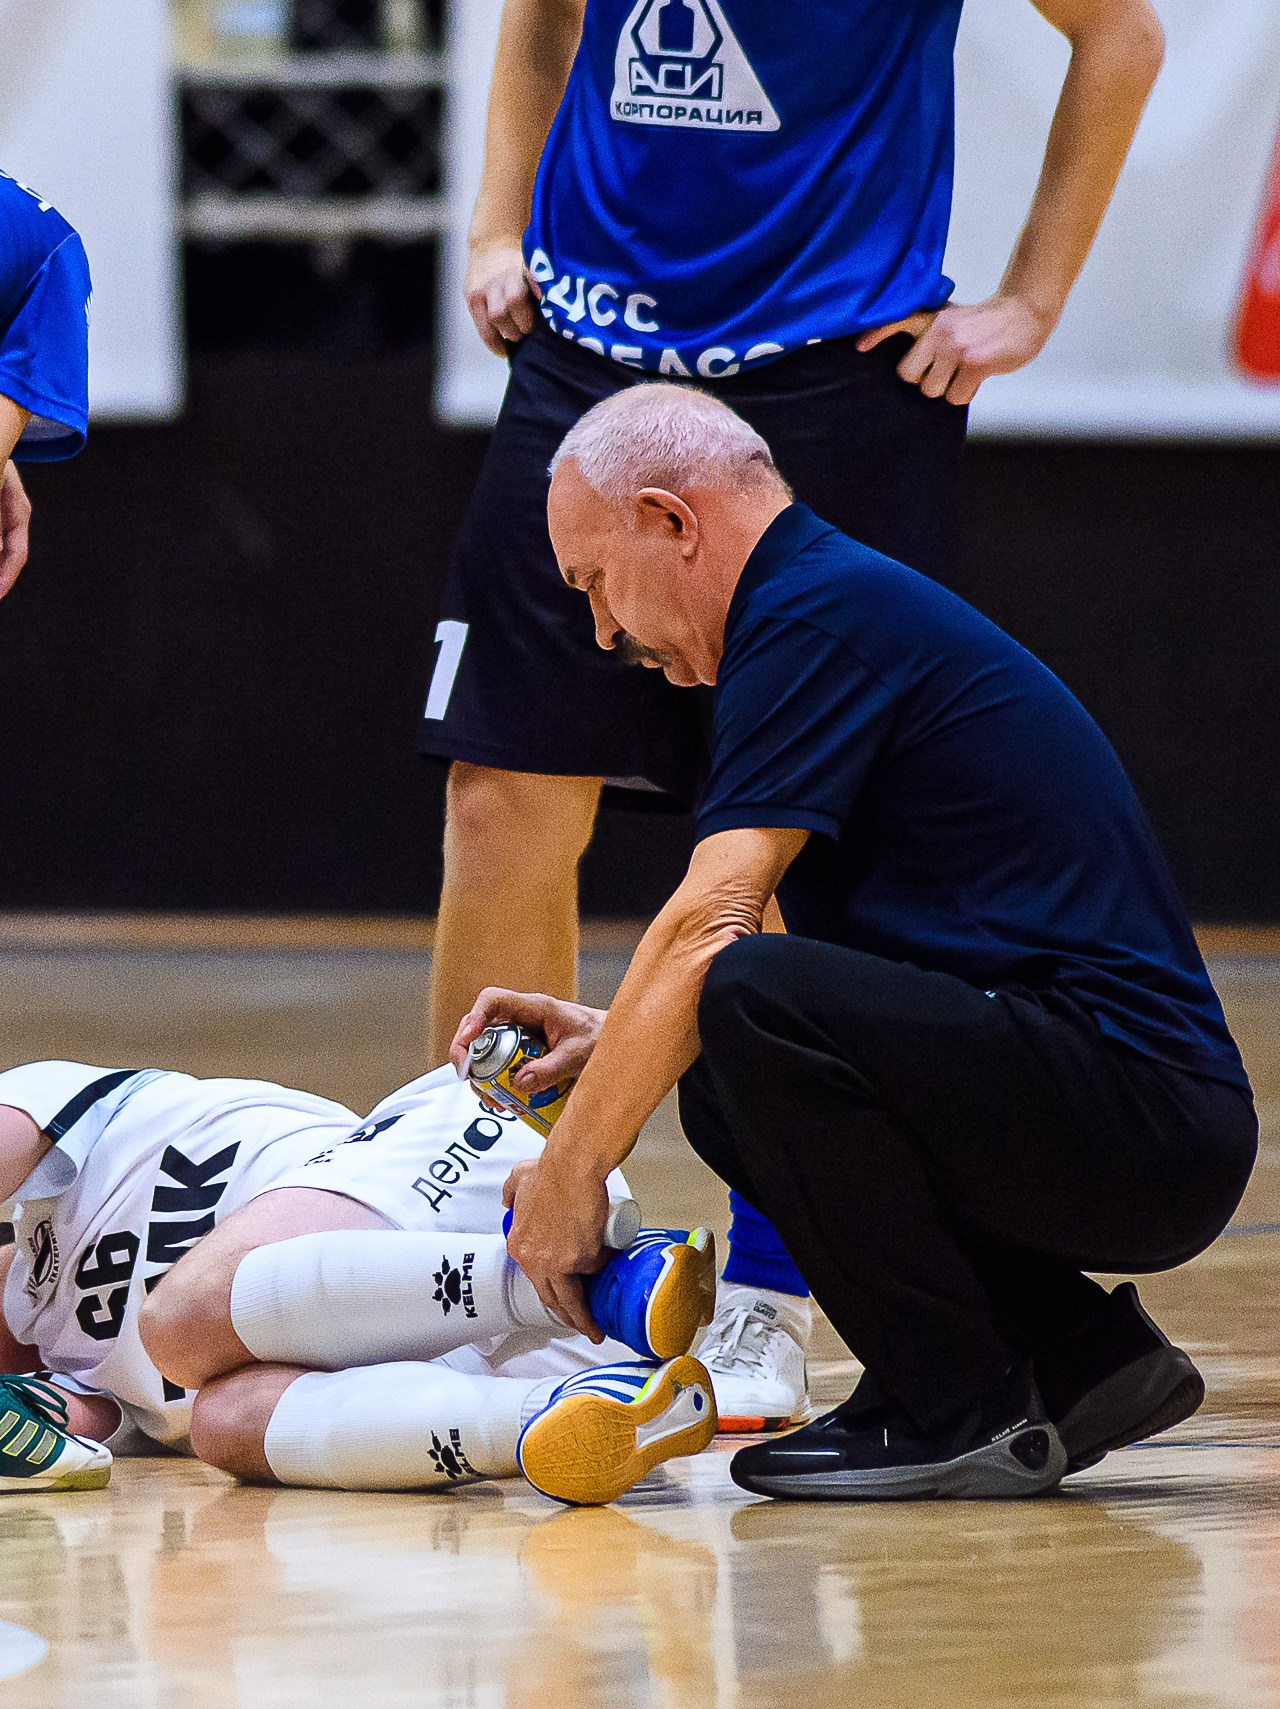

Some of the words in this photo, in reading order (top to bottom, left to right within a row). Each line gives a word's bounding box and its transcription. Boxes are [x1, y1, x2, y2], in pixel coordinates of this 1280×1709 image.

[631, 60, 720, 98] АСИ
[615, 101, 763, 126] КОРПОРАЦИЯ
[424, 619, 469, 721] 1
[462, 1252, 479, 1319] KELME
[449, 1428, 479, 1476] ELME
